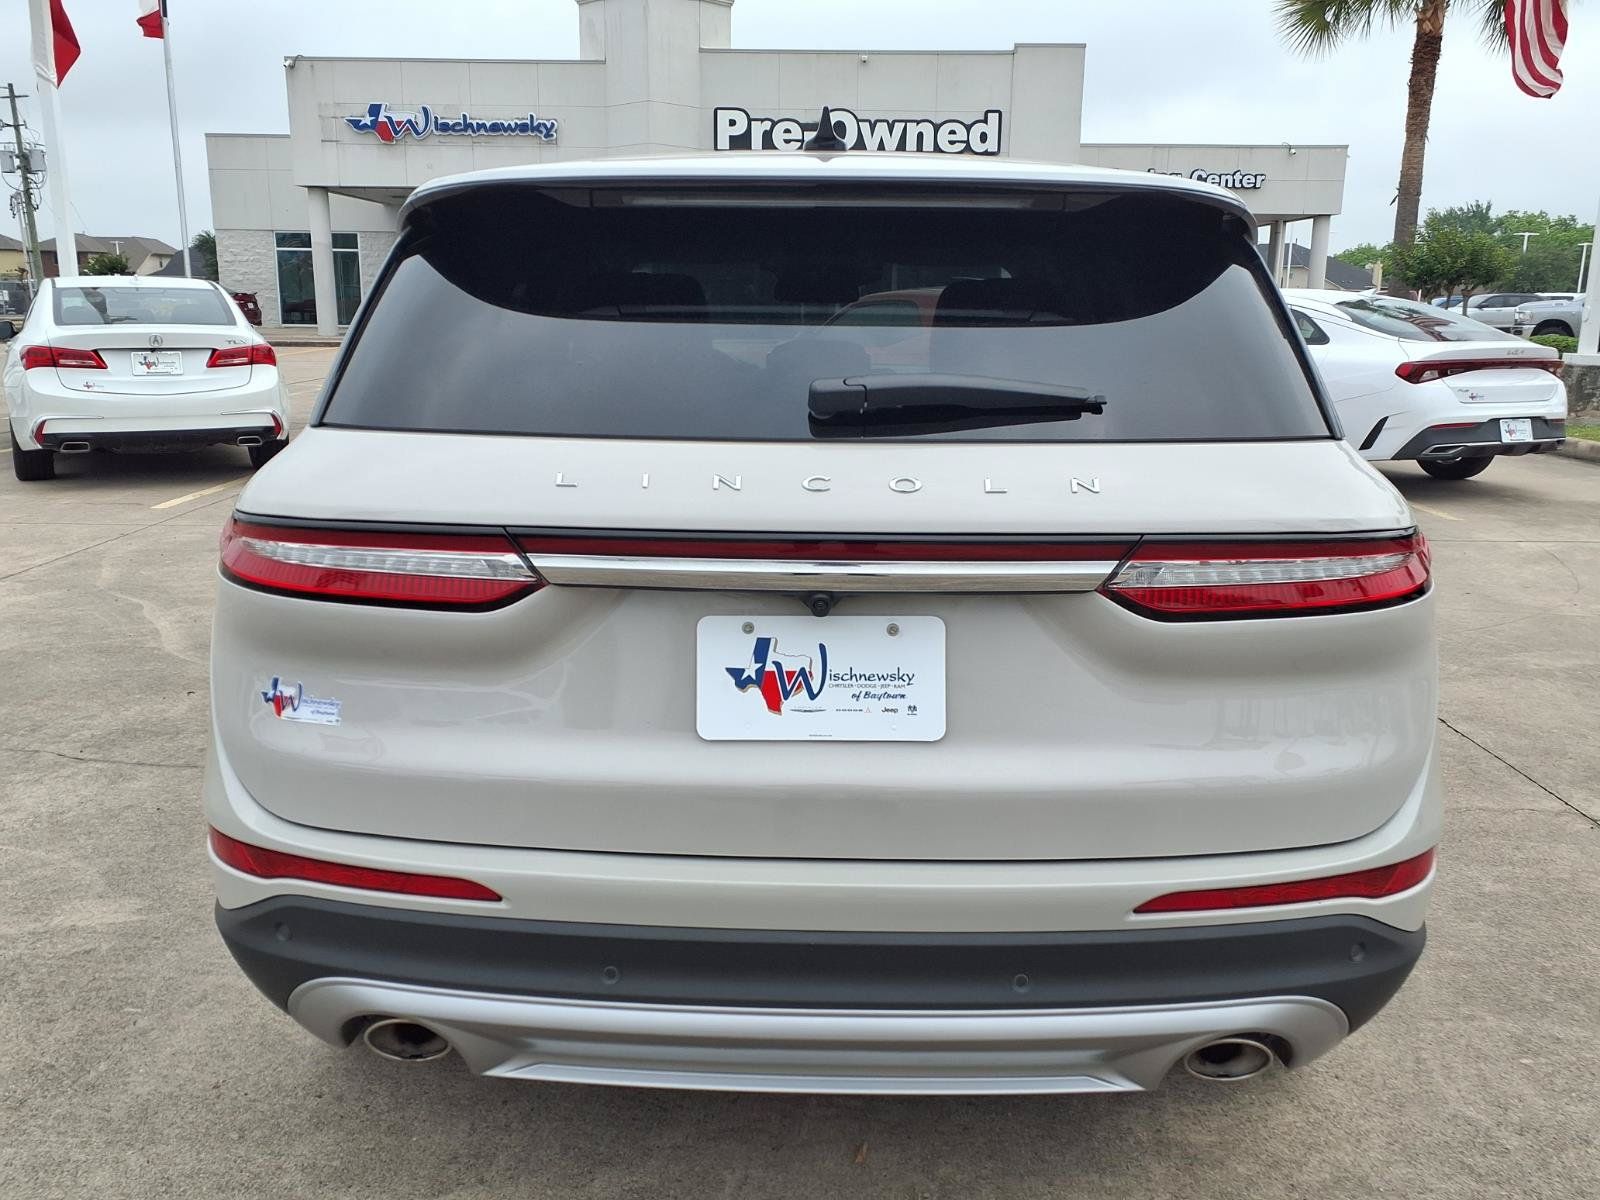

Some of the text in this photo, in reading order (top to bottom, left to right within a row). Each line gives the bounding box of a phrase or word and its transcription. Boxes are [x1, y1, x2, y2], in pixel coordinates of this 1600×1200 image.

[384, 105, 557, 141] Wischnewsky
[555, 471, 1102, 495] LINCOLN
[771, 642, 915, 701] Wischnewsky
[851, 690, 906, 702] of Baytown
[881, 706, 899, 714] Jeep
